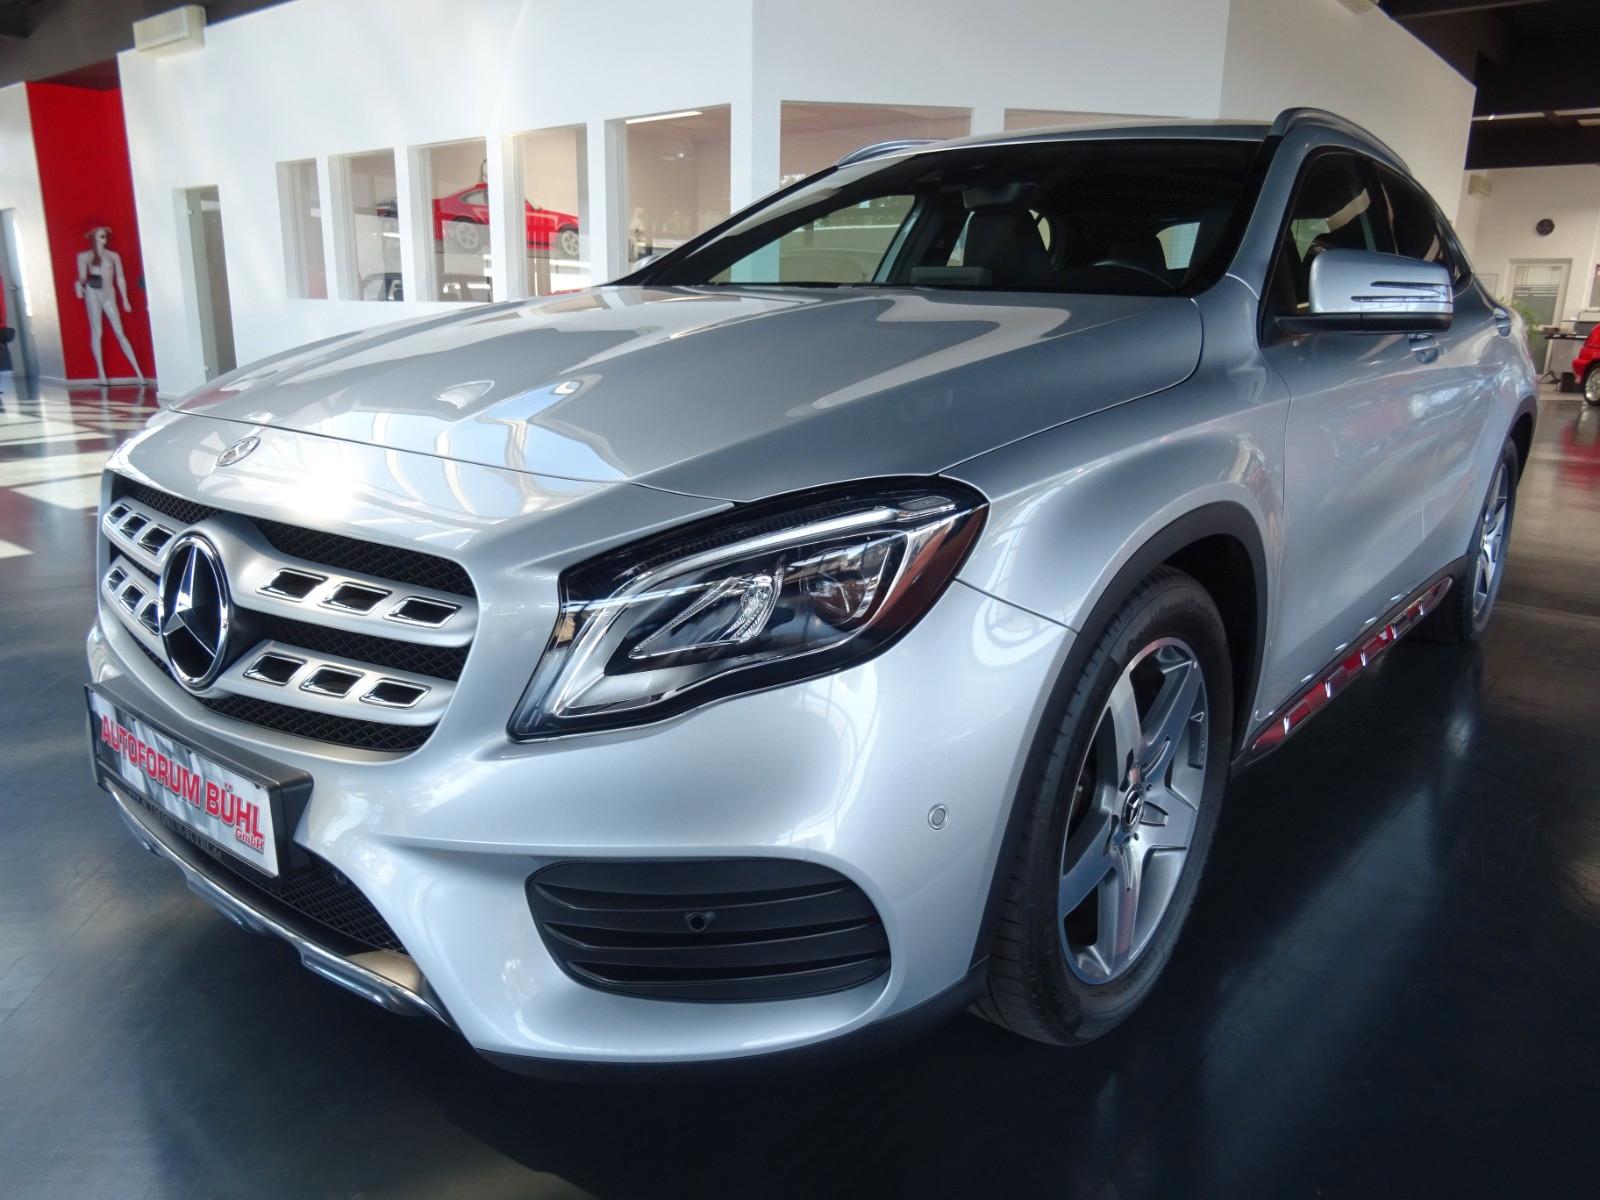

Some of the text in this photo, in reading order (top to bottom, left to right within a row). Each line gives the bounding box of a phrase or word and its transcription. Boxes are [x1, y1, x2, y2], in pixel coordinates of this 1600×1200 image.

[101, 716, 200, 806] AUTOFORUM
[205, 781, 264, 840] BÜHL
[235, 827, 265, 852] GmbH
